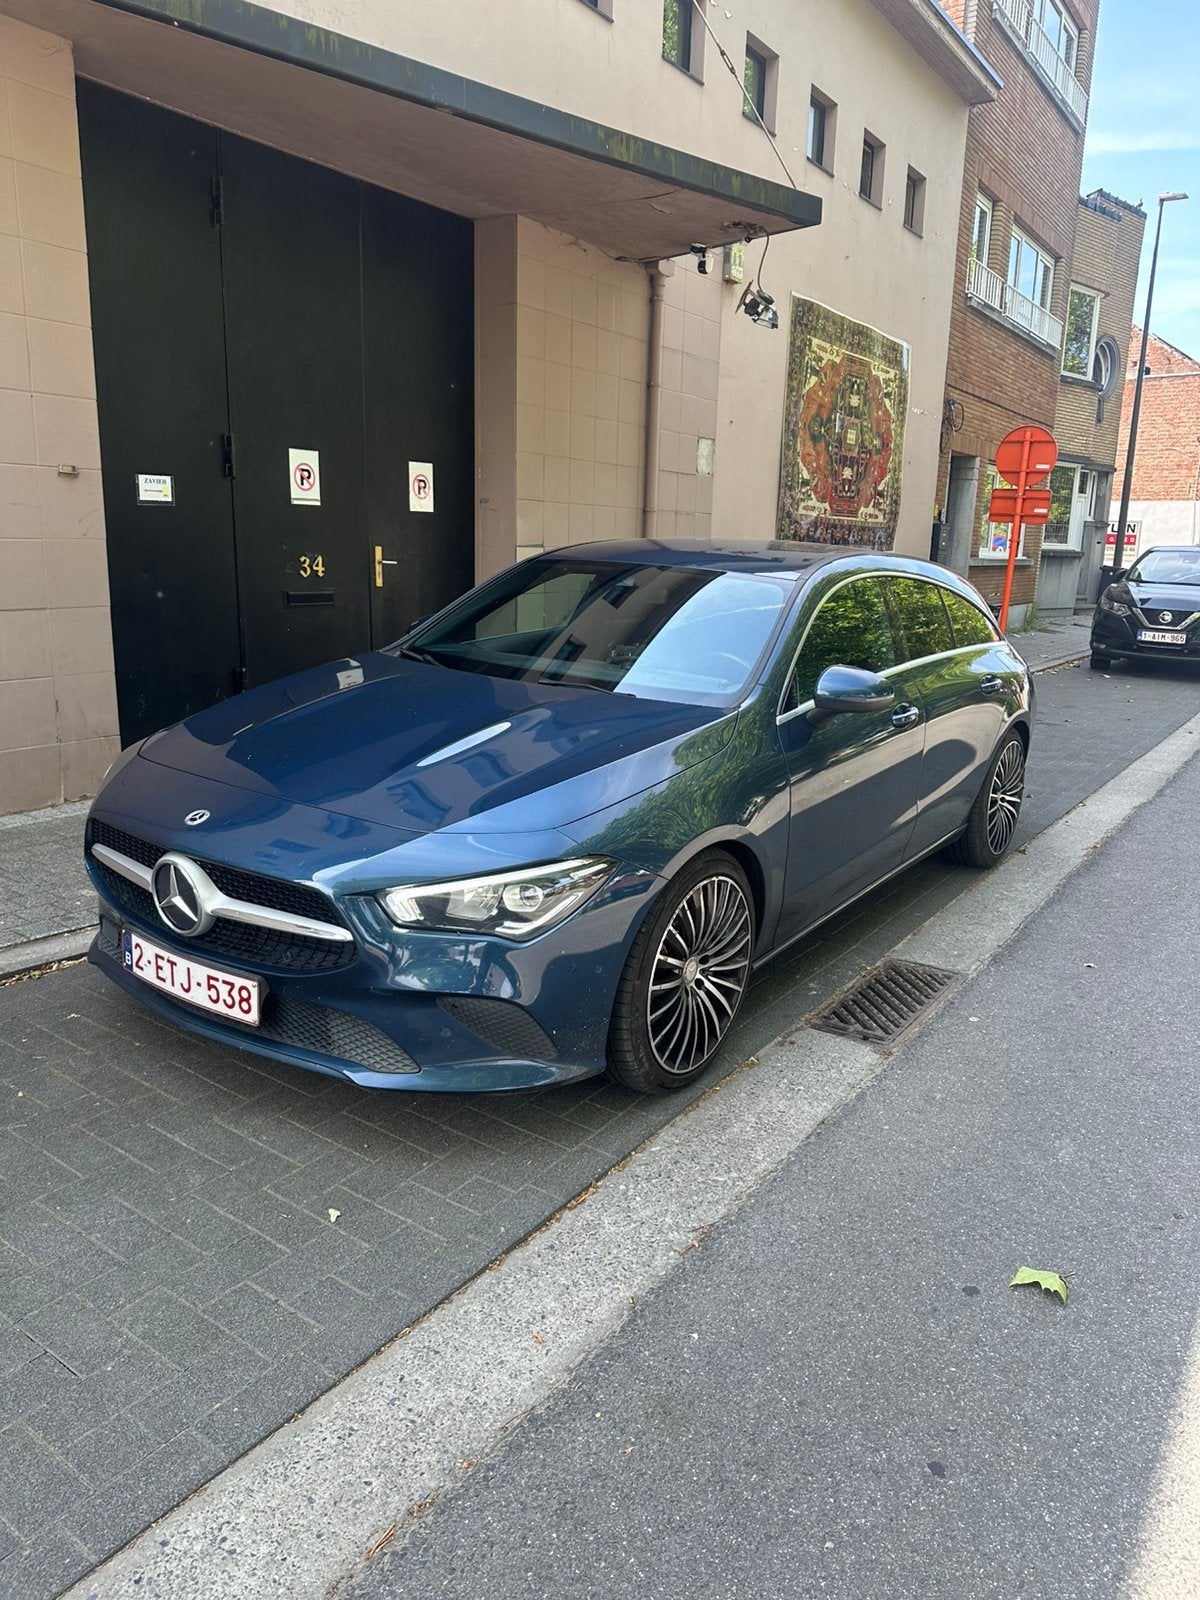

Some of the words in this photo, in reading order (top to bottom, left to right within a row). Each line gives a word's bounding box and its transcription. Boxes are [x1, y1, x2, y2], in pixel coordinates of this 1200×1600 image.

[299, 555, 325, 578] 34
[125, 951, 132, 966] B
[134, 942, 252, 1015] 2-ETJ-538
